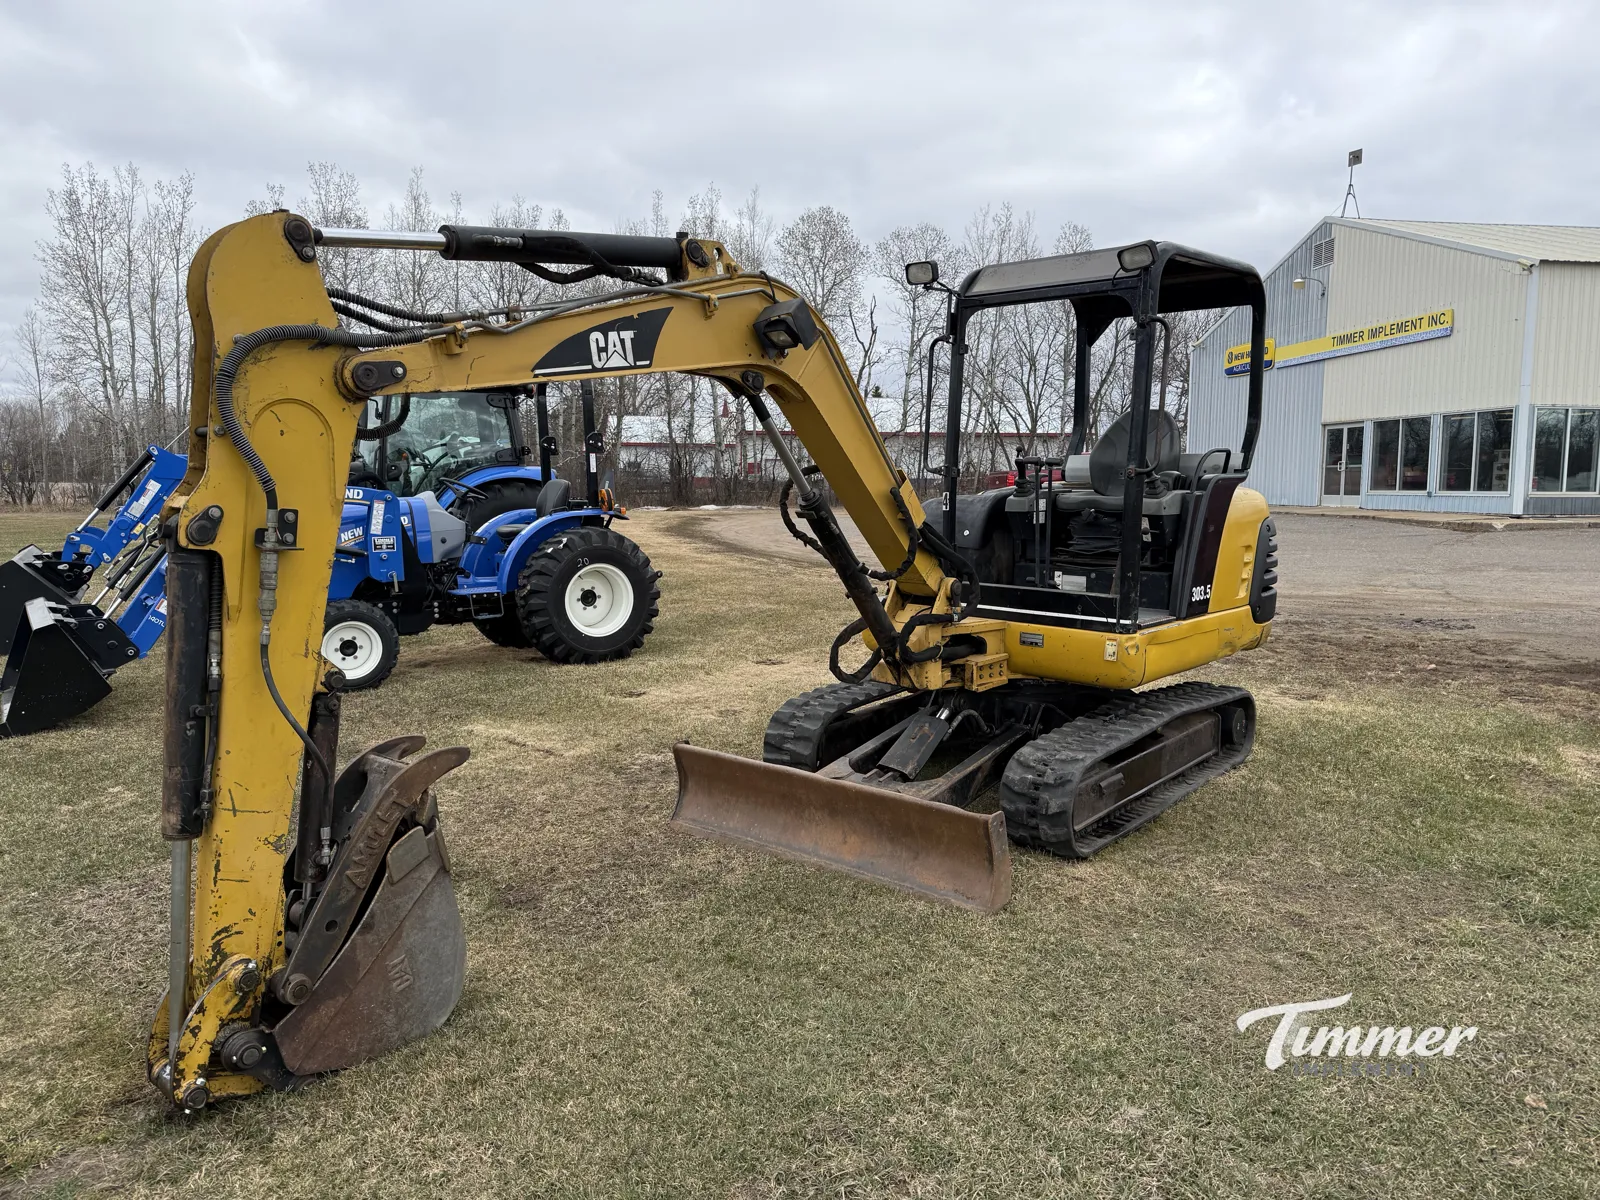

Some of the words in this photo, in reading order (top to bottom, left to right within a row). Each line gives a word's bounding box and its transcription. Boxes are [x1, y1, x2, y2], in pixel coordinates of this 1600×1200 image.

[1331, 330, 1365, 347] TIMMER
[1367, 317, 1424, 340] IMPLEMENT
[1427, 312, 1449, 328] INC.
[589, 330, 635, 369] CAT
[1233, 352, 1245, 362] NEW
[340, 526, 364, 543] NEW
[1191, 584, 1211, 602] 303.5
[345, 787, 409, 890] AMULET
